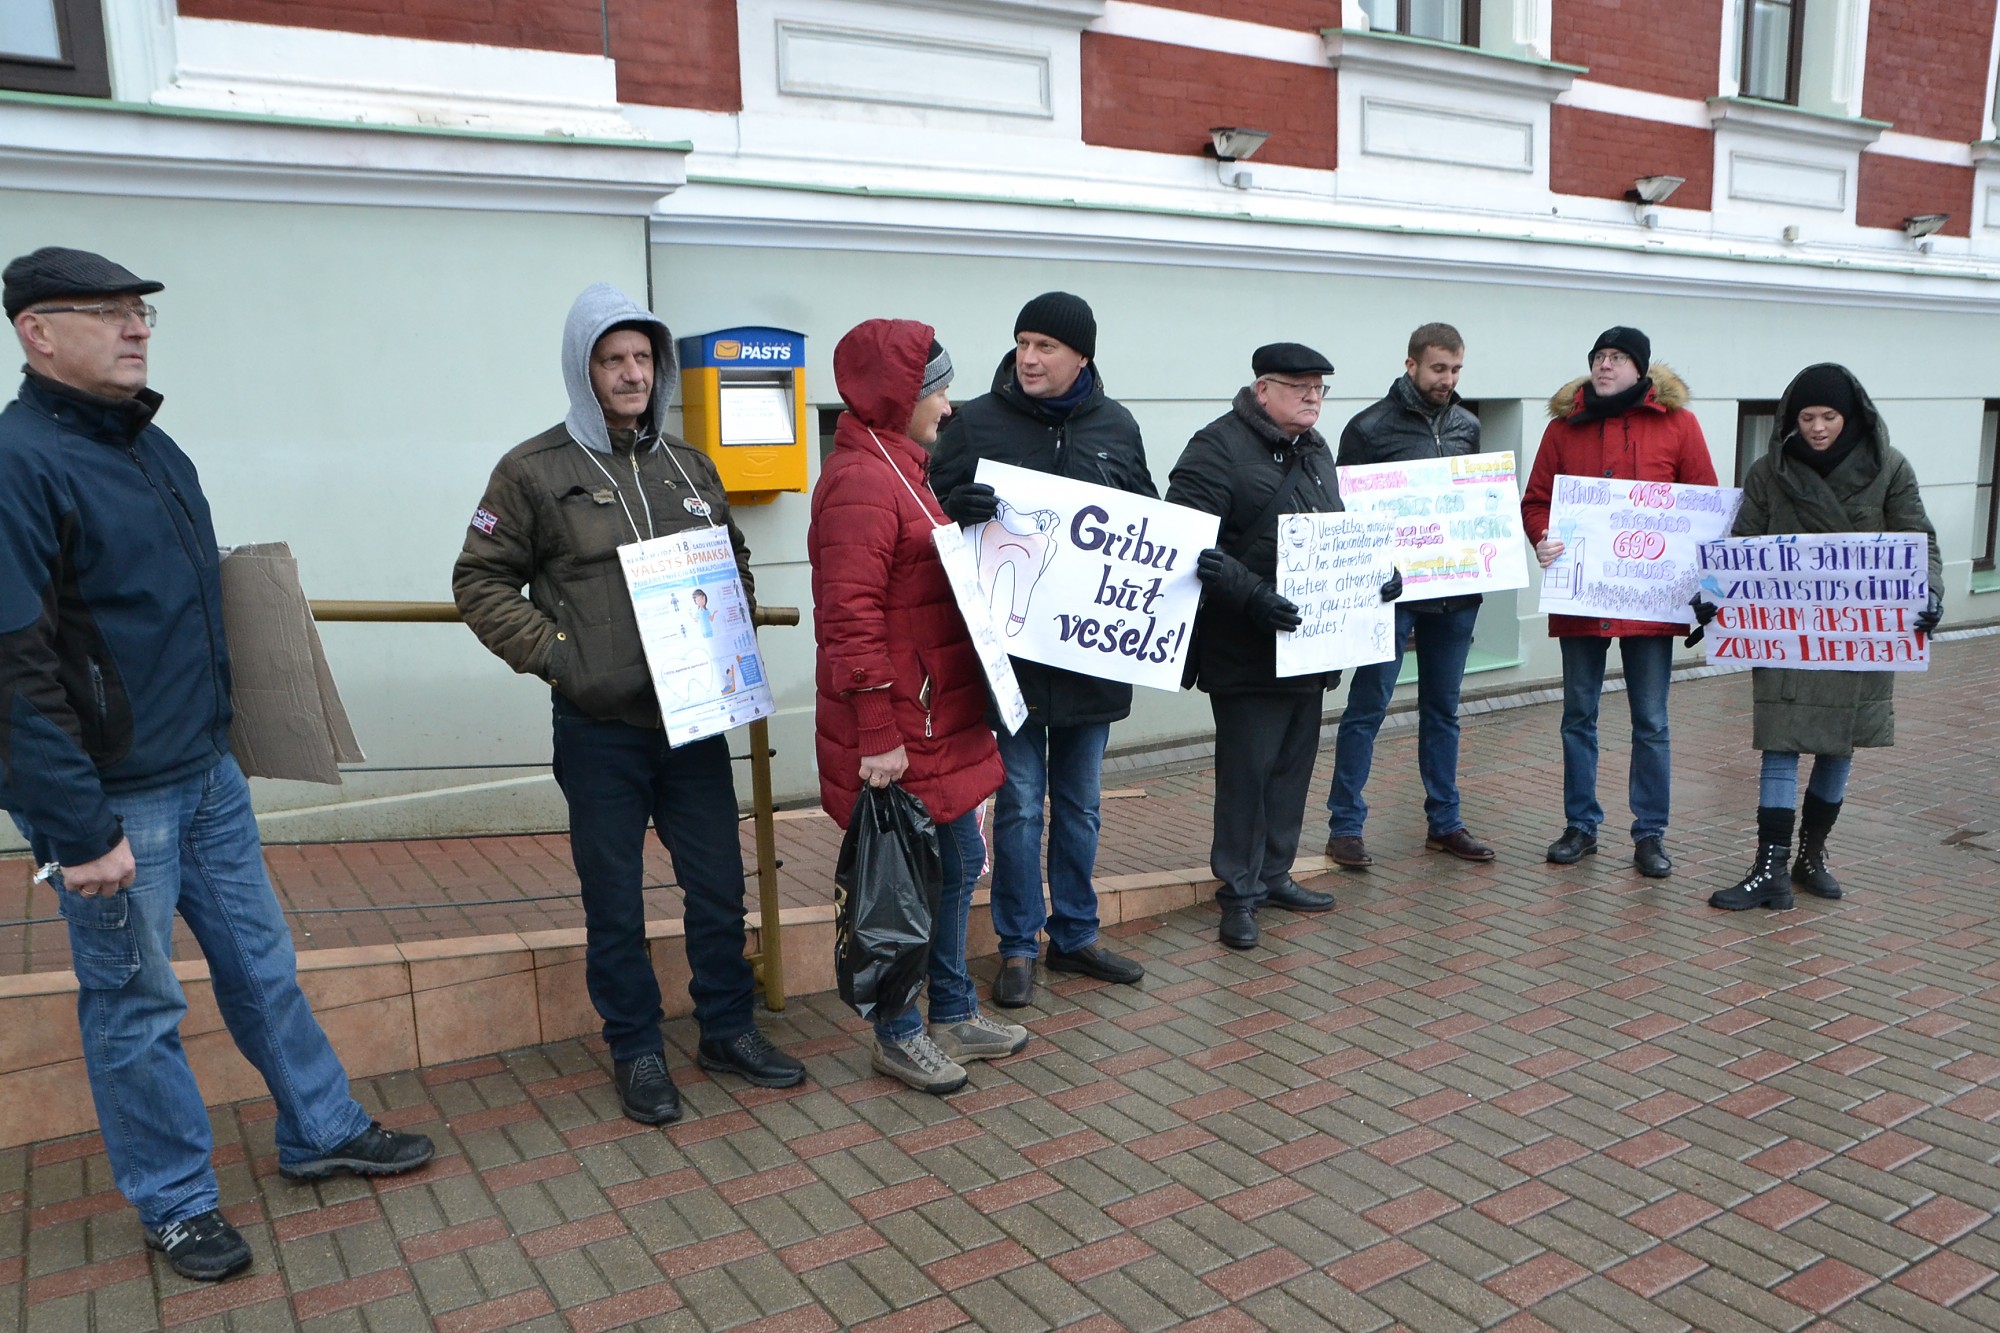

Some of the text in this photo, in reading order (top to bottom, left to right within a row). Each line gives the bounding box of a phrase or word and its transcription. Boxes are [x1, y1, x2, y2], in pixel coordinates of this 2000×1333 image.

[740, 346, 791, 360] PASTS
[676, 540, 690, 552] 18
[1070, 505, 1178, 572] Gribu
[1613, 530, 1666, 560] 690
[630, 556, 683, 578] VALSTS
[1094, 564, 1164, 615] būt
[1316, 598, 1339, 620] jau
[1716, 604, 1909, 633] GRIBAM ĀRSTĒT
[1053, 614, 1186, 664] vesels!
[1715, 636, 1786, 660] ZOBUS
